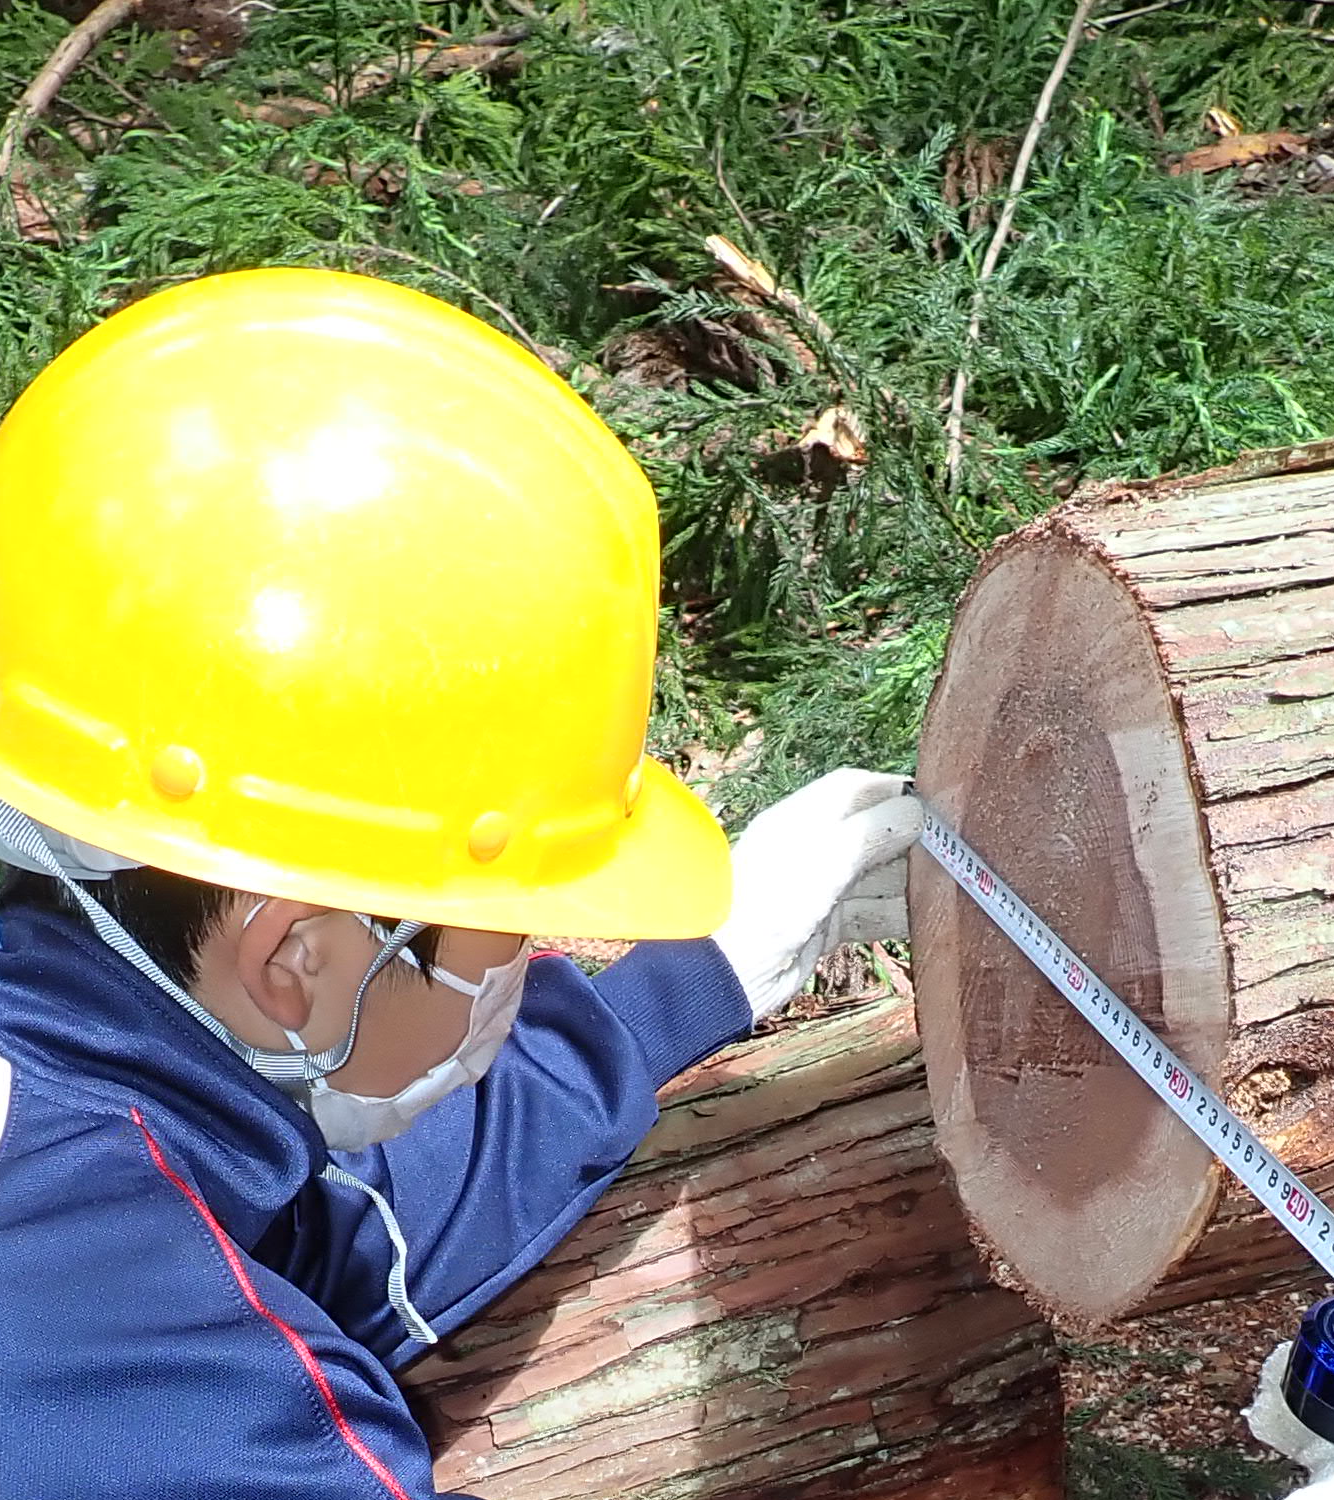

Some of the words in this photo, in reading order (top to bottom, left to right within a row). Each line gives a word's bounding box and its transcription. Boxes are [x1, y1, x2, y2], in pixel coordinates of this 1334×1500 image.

[926, 816, 932, 830] 3
[934, 826, 941, 839] 4
[942, 833, 948, 846] 5
[950, 840, 956, 855] 6
[959, 849, 966, 863] 7
[965, 858, 972, 872] 8
[974, 866, 981, 881] 9
[992, 884, 997, 897] 1
[999, 892, 1007, 908] 2
[1026, 920, 1033, 936] 5
[1044, 939, 1052, 954] 7
[1053, 948, 1061, 964] 8
[1062, 958, 1070, 973] 9
[1069, 965, 1082, 989] 20
[1083, 979, 1089, 994] 1
[1091, 989, 1100, 1004] 2
[1101, 998, 1110, 1015] 3
[1112, 1010, 1119, 1026] 4
[1122, 1019, 1130, 1035] 5
[1131, 1030, 1140, 1047] 6
[1143, 1040, 1151, 1056] 7
[1153, 1051, 1162, 1068] 8
[1164, 1062, 1172, 1080] 9
[1171, 1072, 1187, 1096] 30
[1187, 1086, 1195, 1102] 1
[1196, 1097, 1207, 1115] 2
[1209, 1109, 1218, 1127] 3
[1221, 1122, 1229, 1140] 4
[1232, 1133, 1242, 1150] 5
[1244, 1144, 1254, 1163] 6
[1256, 1157, 1267, 1174] 7
[1268, 1169, 1278, 1188] 8
[1280, 1182, 1291, 1200] 9
[1288, 1194, 1307, 1218] 40
[1308, 1209, 1316, 1226] 1
[1318, 1222, 1330, 1242] 2
